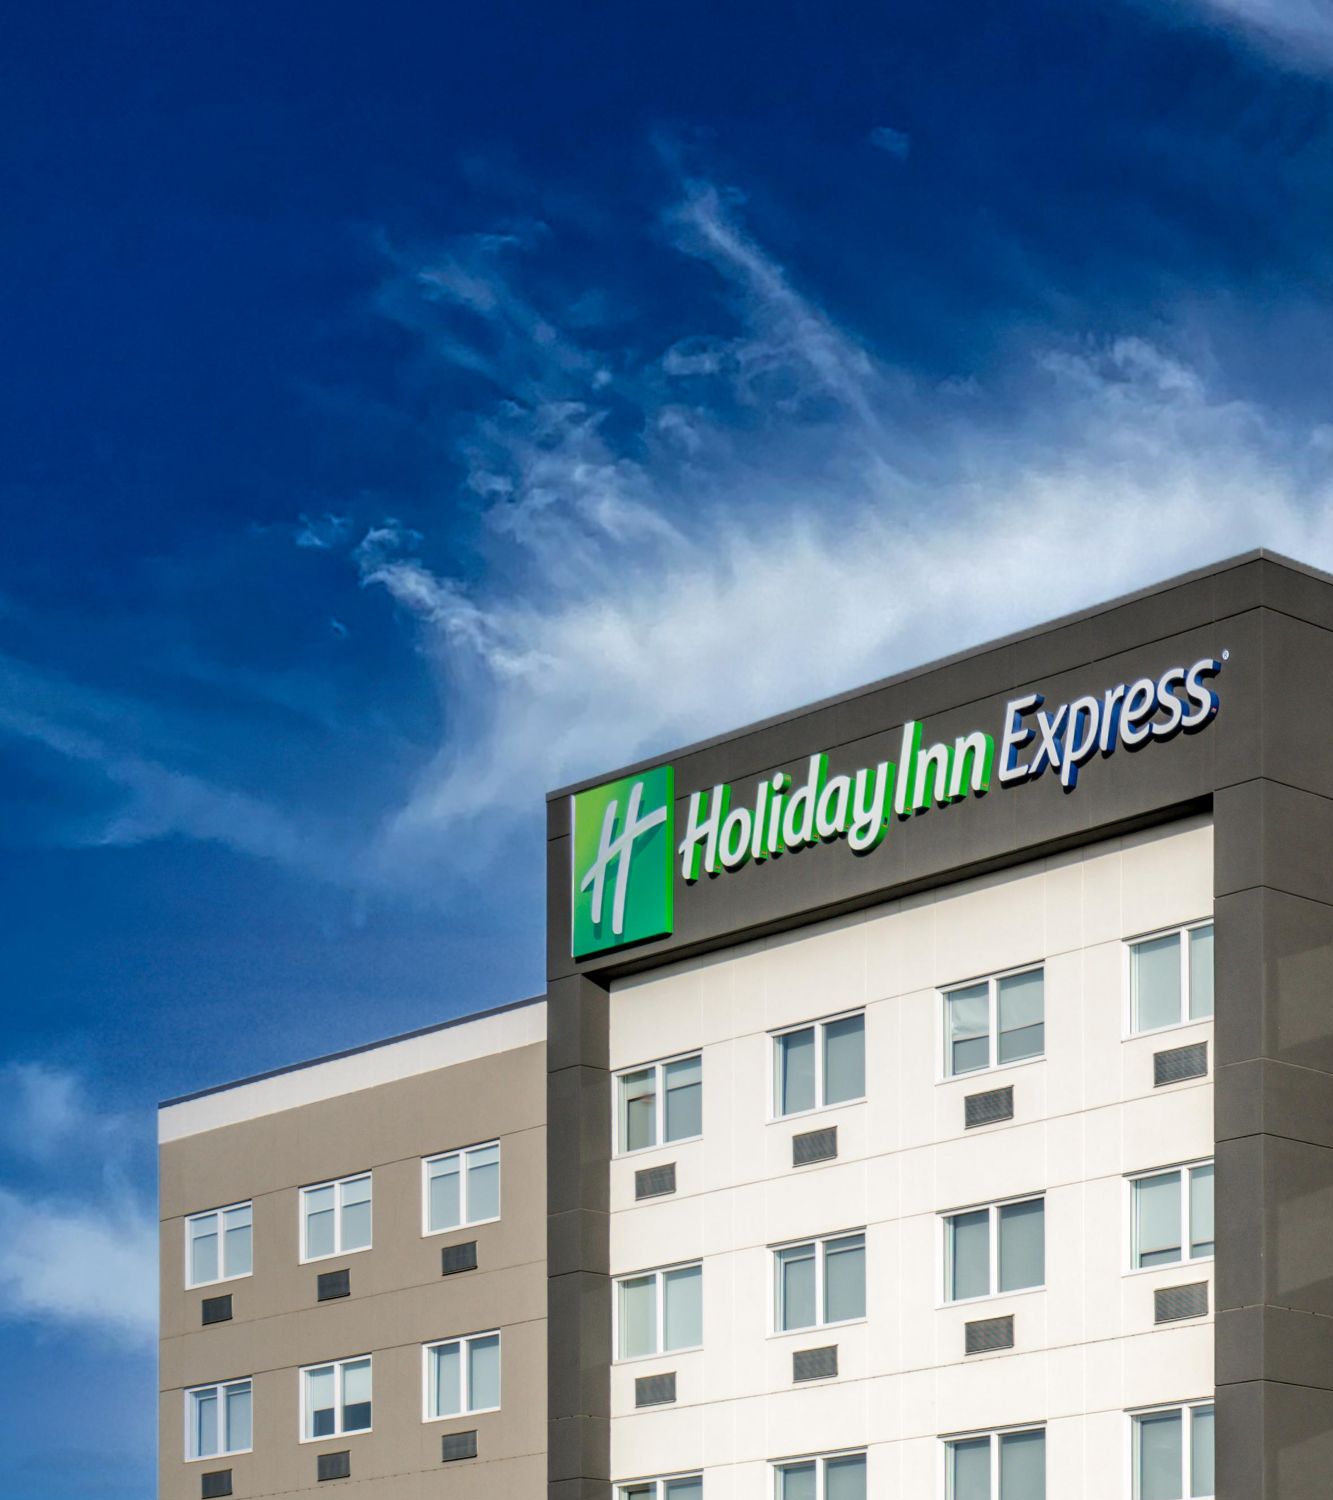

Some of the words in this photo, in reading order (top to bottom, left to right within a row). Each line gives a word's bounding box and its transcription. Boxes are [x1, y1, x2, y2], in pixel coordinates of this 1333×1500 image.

[678, 752, 896, 880] Holiday
[895, 720, 994, 816] Inn
[998, 658, 1222, 786] Express
